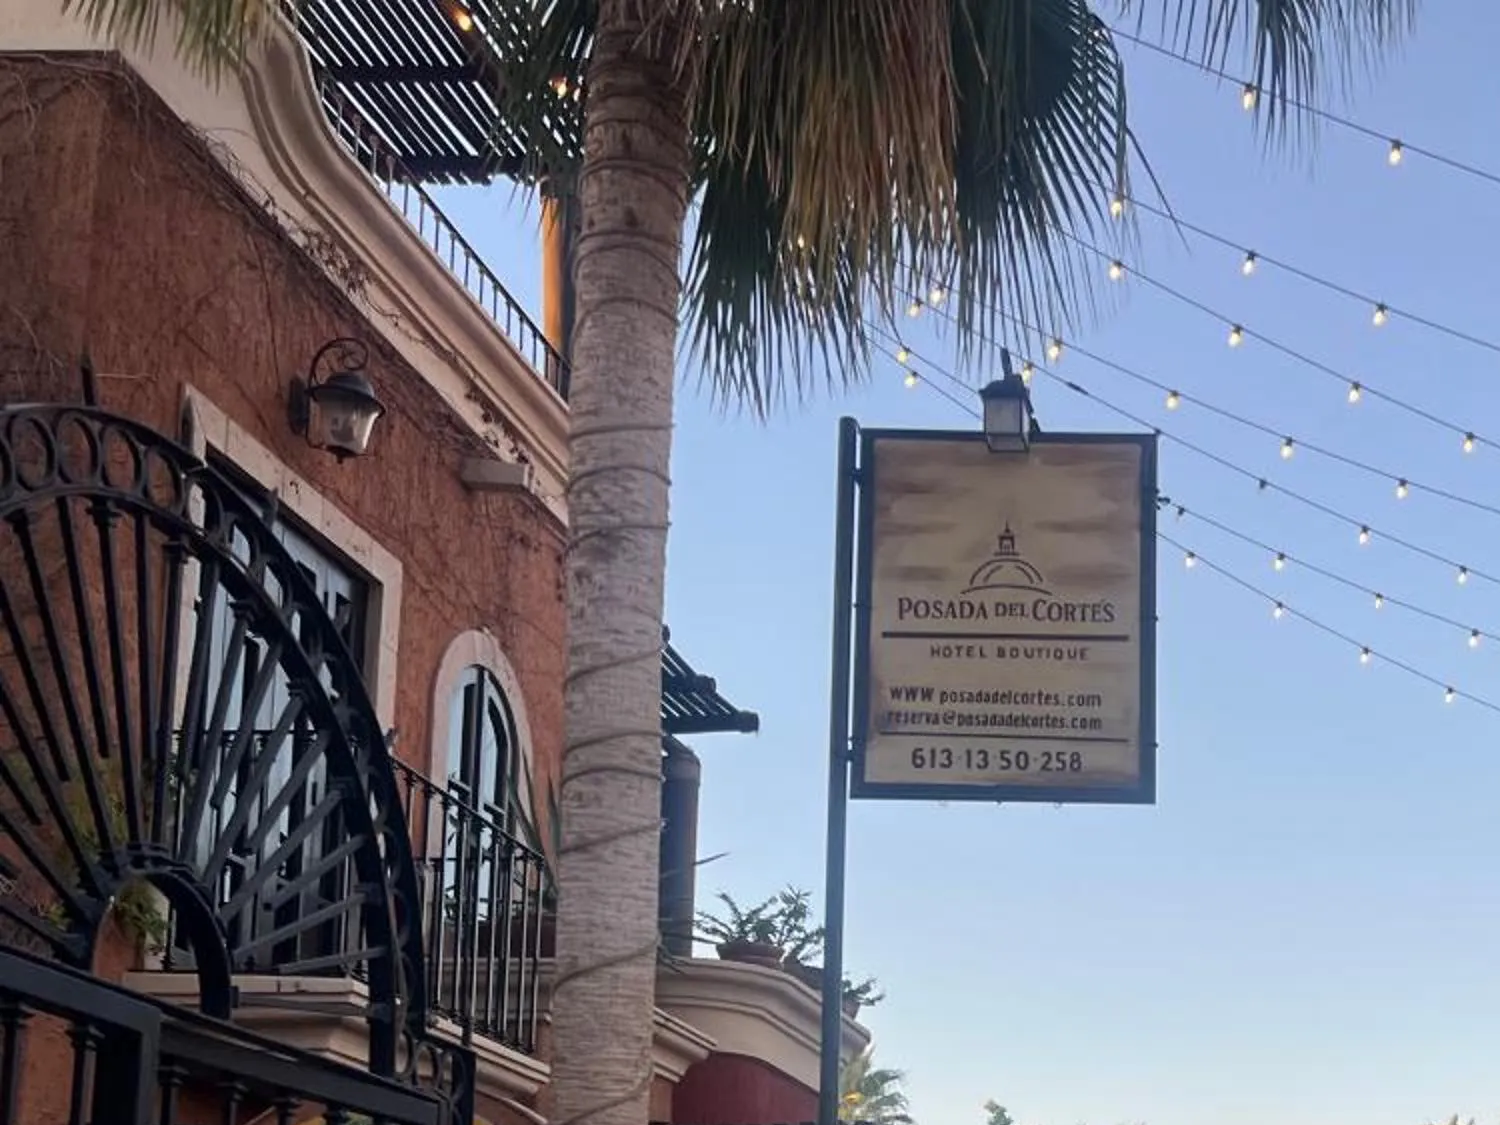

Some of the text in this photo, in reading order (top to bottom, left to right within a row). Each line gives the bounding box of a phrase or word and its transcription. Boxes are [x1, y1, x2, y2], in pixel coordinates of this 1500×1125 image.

[898, 597, 988, 620] POSADA
[995, 601, 1028, 617] DEL
[930, 645, 1090, 661] HOTEL BOUTIQUE
